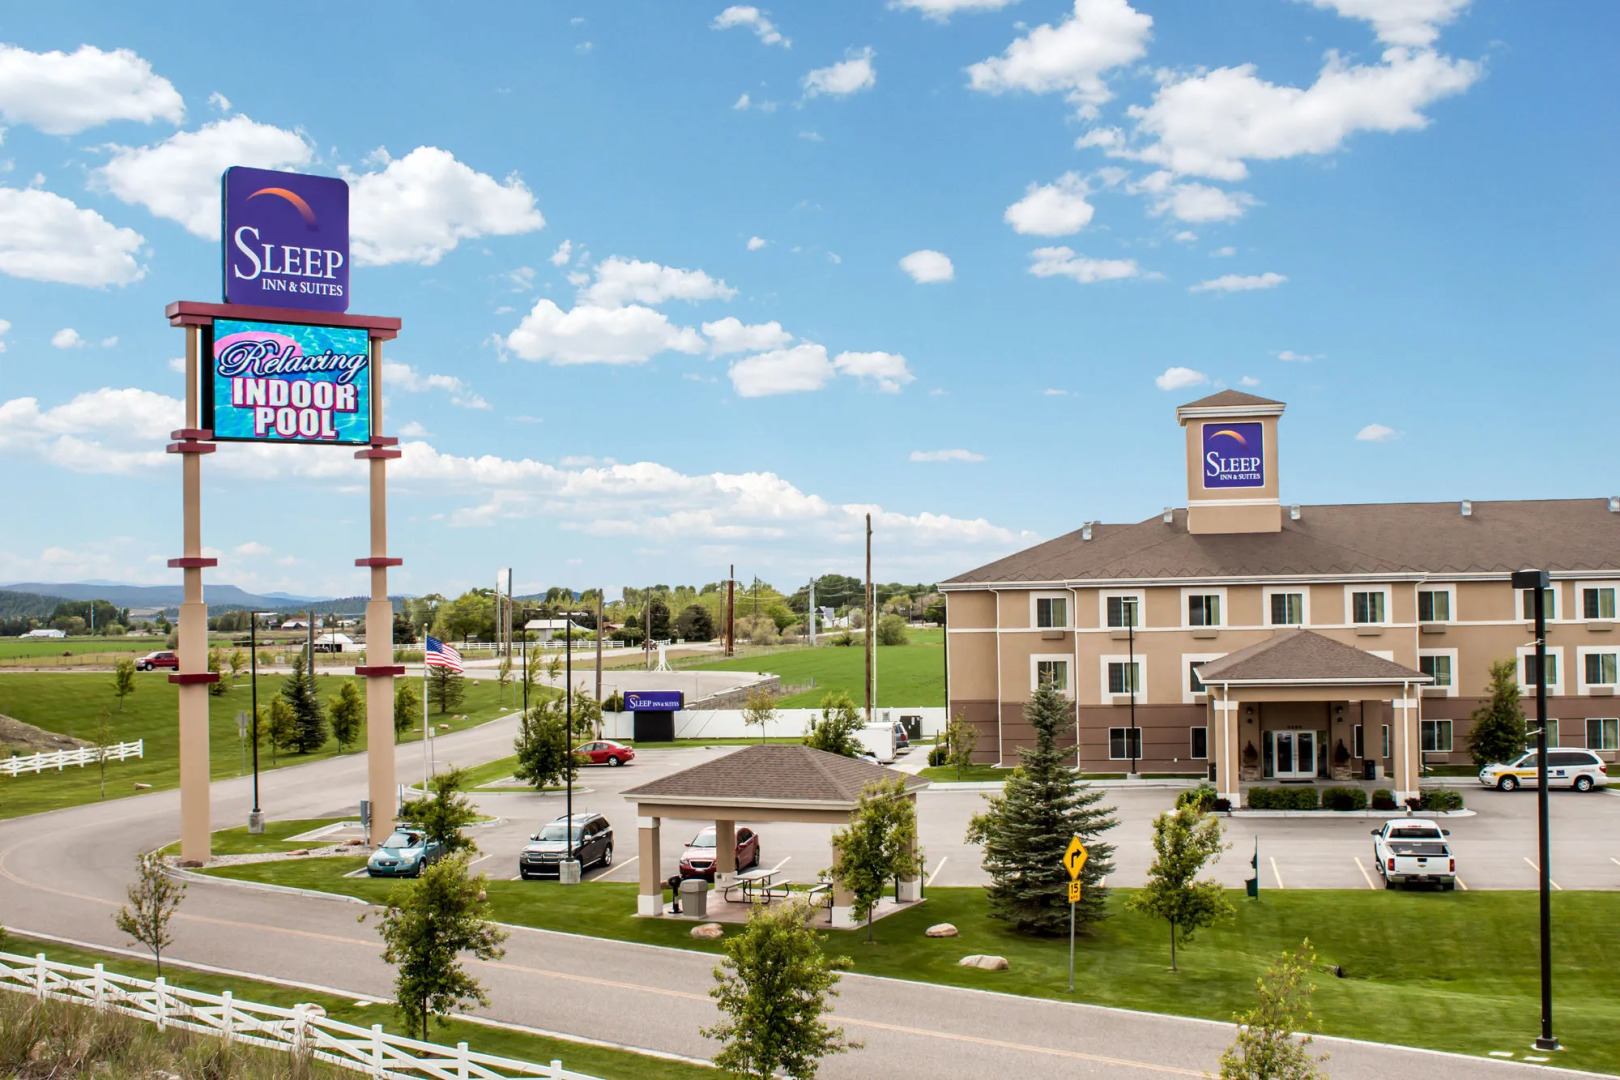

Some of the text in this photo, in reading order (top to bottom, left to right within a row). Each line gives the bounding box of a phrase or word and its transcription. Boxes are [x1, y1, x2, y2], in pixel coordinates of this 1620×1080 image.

[234, 226, 344, 280] SLEEP
[262, 278, 343, 297] INN & SUITES
[218, 340, 368, 385] Relaxing
[232, 376, 357, 411] INDOOR
[254, 406, 338, 438] POOL
[1206, 452, 1260, 476] SLEEP
[630, 698, 652, 708] SLEEP
[1070, 883, 1078, 894] 15
